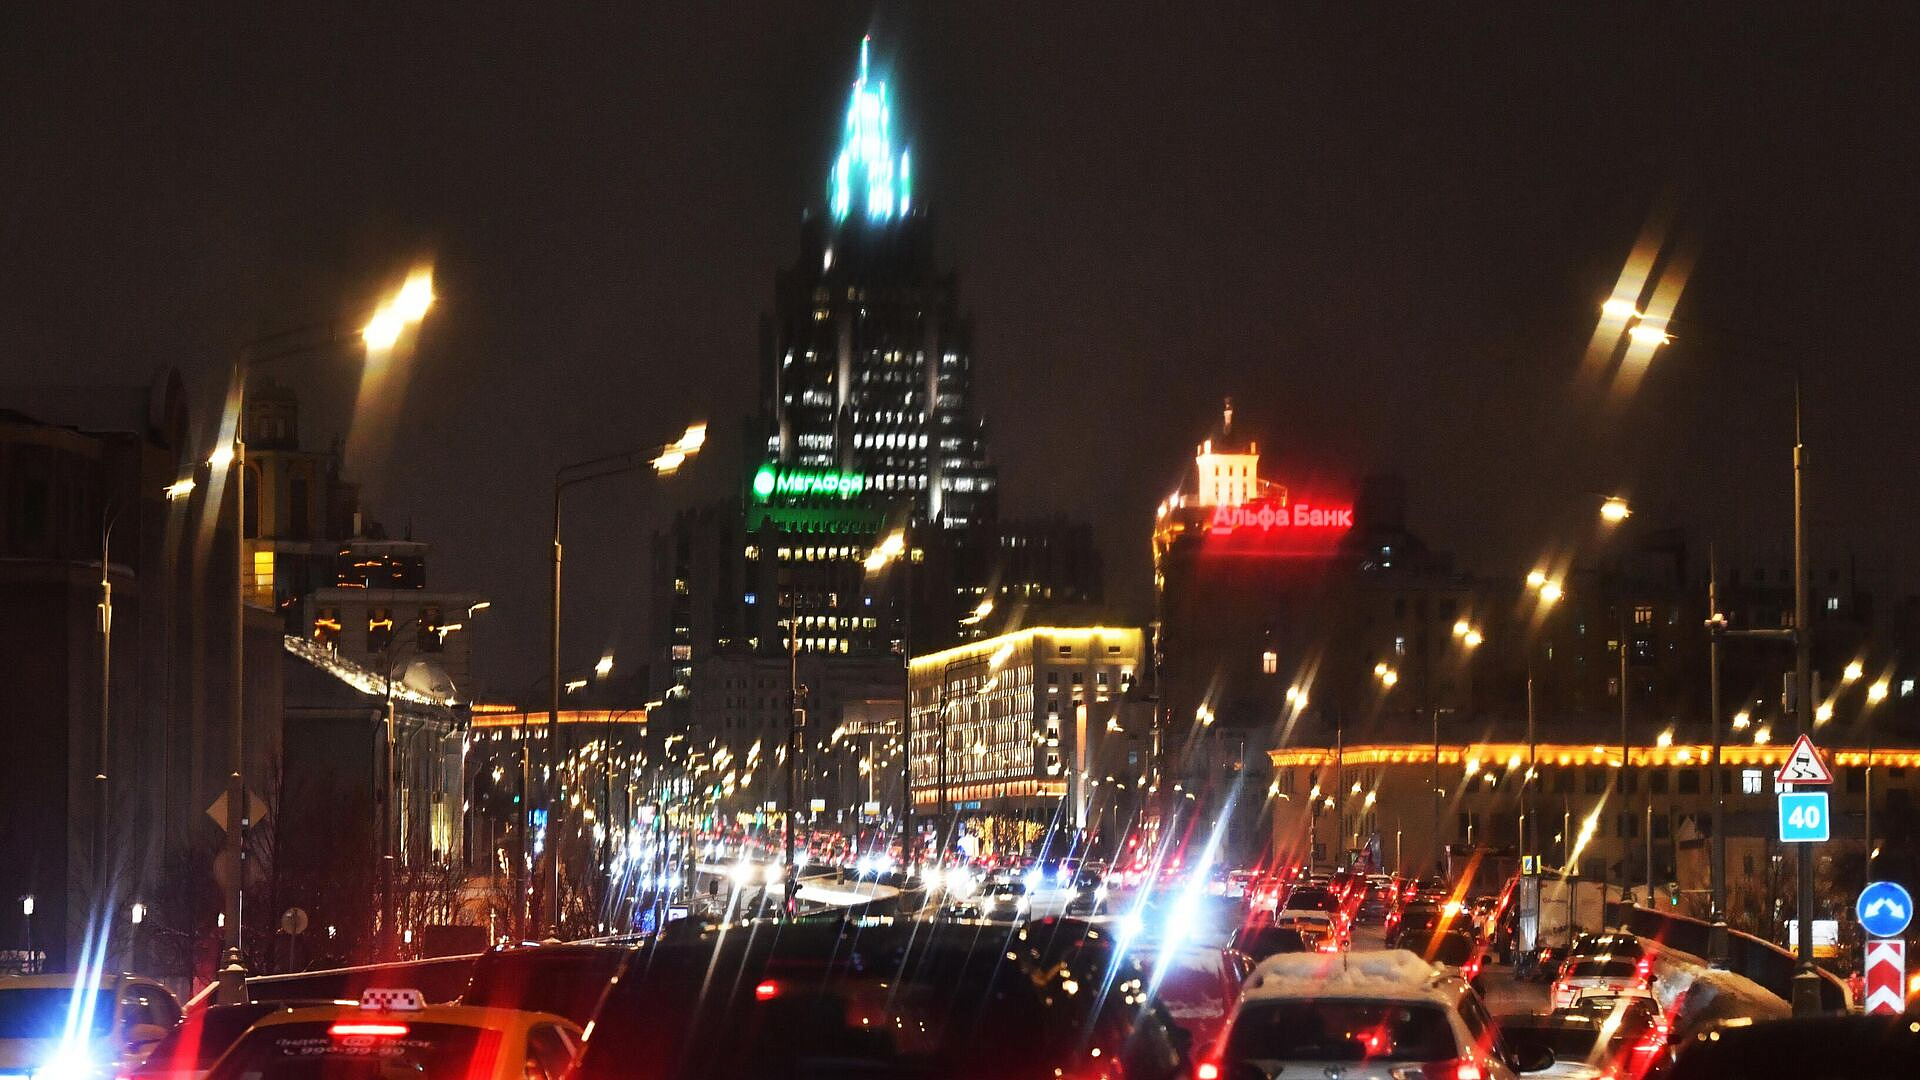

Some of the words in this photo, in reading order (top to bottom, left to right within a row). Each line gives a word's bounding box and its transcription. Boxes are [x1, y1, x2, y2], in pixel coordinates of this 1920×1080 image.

[1212, 503, 1289, 533] Альфа
[1294, 504, 1352, 527] Банк
[1788, 806, 1820, 828] 40
